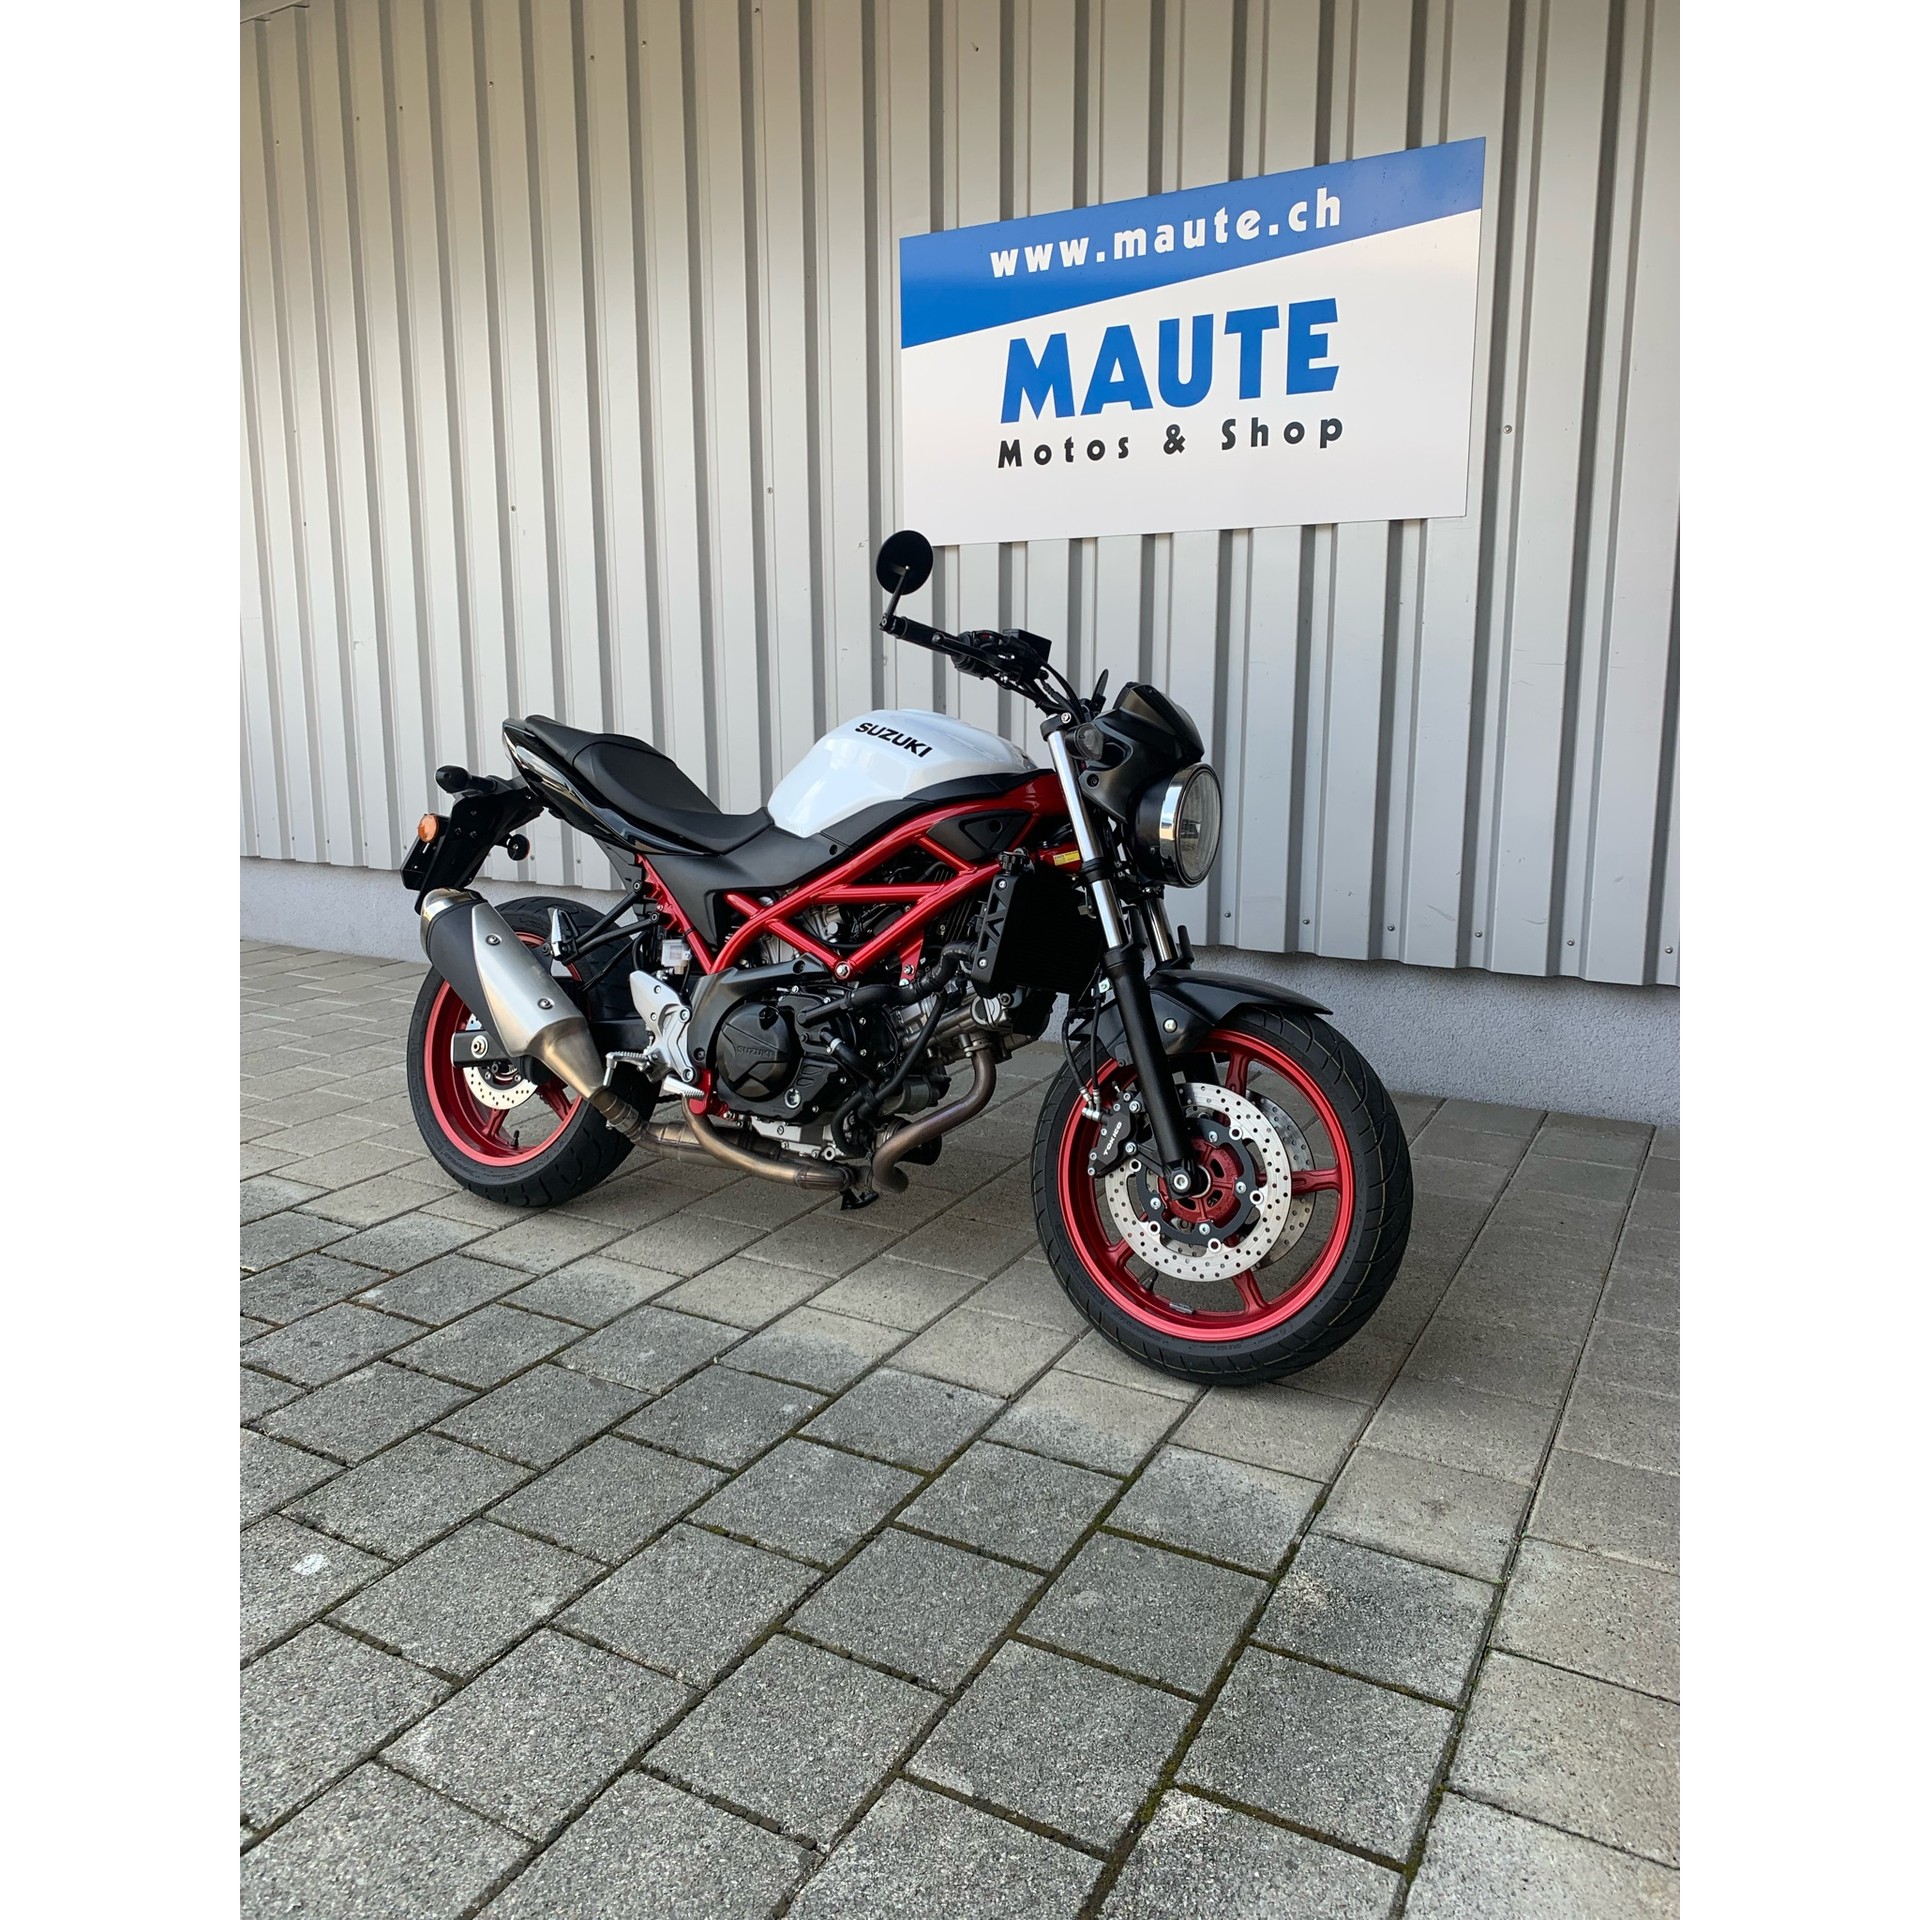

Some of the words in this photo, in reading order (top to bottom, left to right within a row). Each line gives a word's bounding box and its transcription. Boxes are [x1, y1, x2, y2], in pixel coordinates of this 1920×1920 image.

[991, 187, 1341, 278] www.maute.ch
[1000, 297, 1340, 424] MAUTE
[997, 436, 1130, 469] Motos
[1163, 423, 1186, 455] &
[1221, 416, 1343, 450] Shop
[855, 722, 933, 758] SUZUKI
[737, 1045, 773, 1059] SUZUKI
[1103, 1121, 1123, 1156] TOKICO
